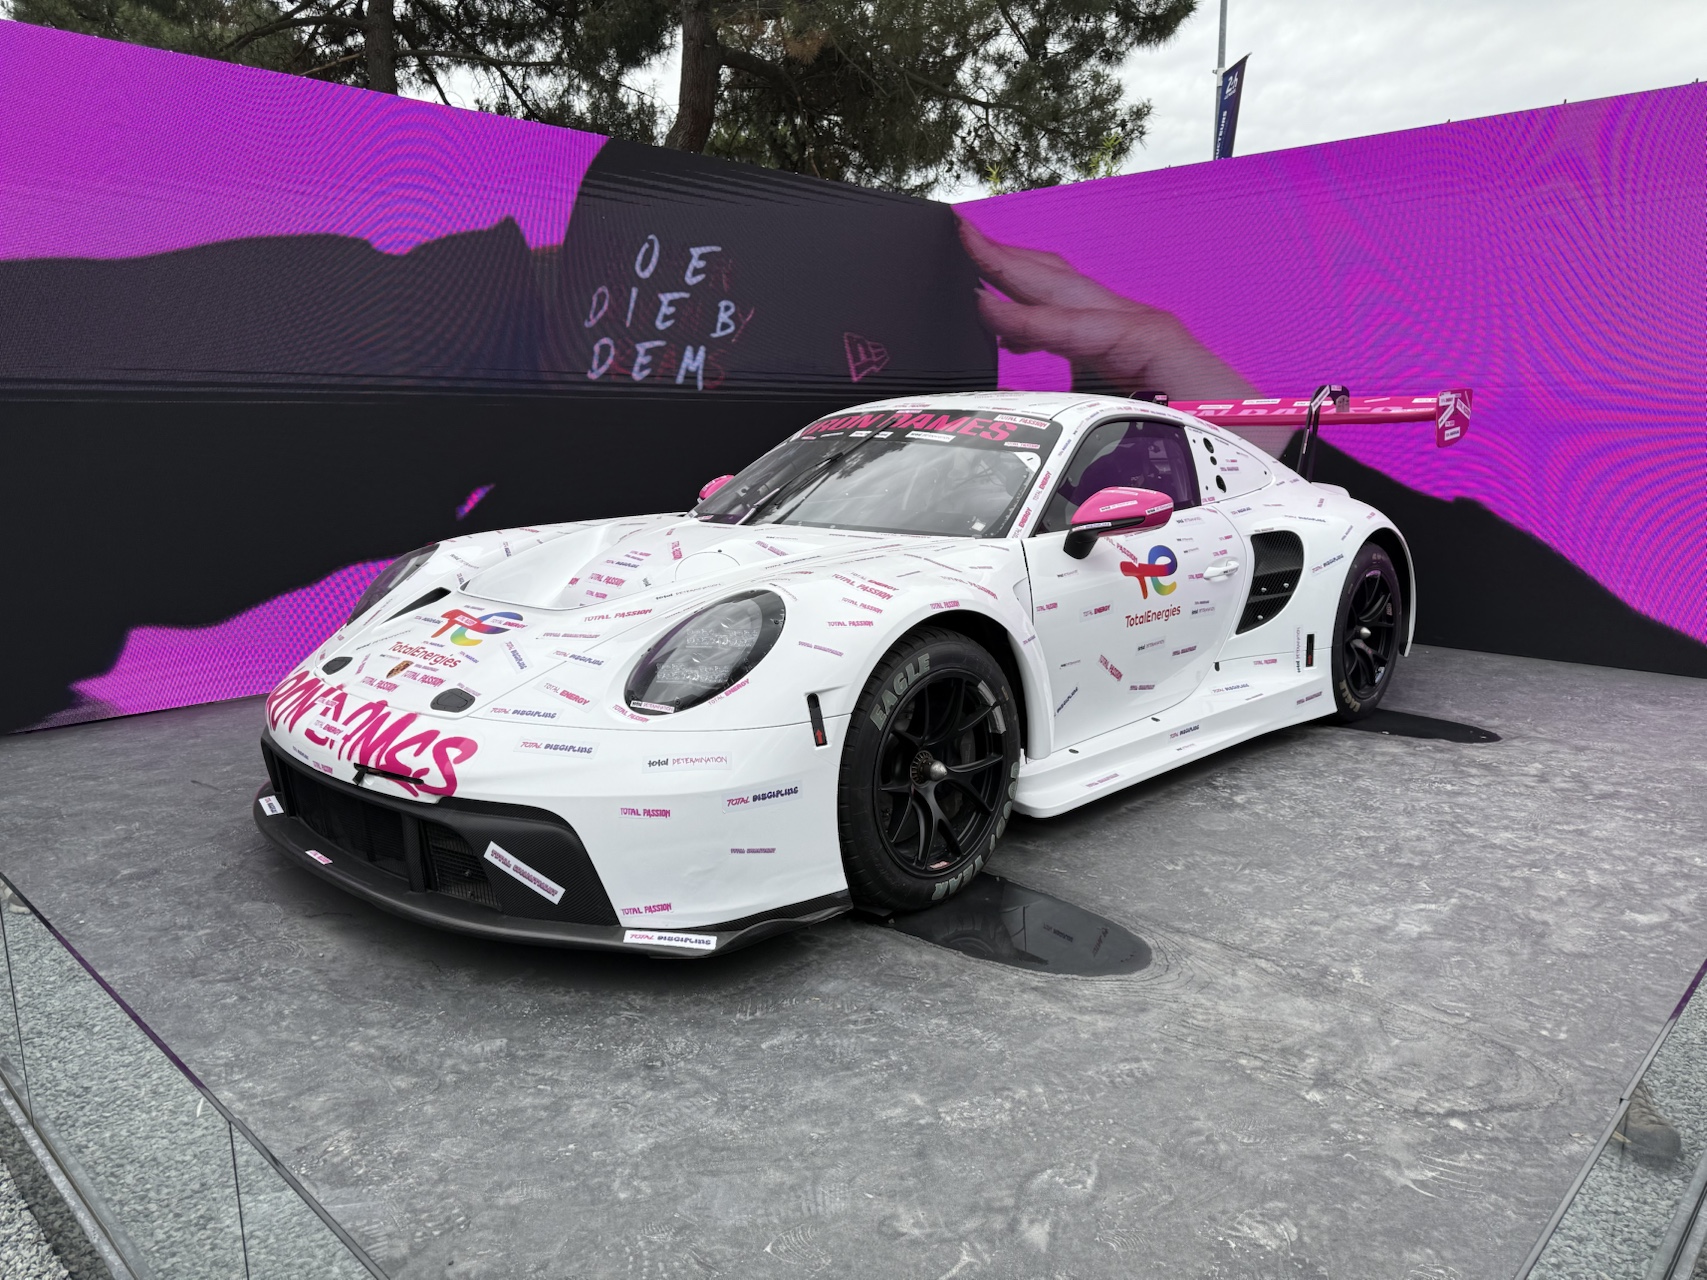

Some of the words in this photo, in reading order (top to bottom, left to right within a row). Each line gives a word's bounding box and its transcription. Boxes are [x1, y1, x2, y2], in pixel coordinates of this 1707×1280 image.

[876, 411, 1018, 441] DAMES
[1039, 471, 1052, 490] ENERGY
[1018, 507, 1033, 528] ENERGY
[832, 573, 855, 587] TOTAL
[857, 583, 894, 600] PASSION
[583, 614, 611, 623] TOTAL
[613, 608, 653, 619] PASSION
[1125, 603, 1181, 628] TotalEnergies
[388, 641, 461, 668] TotalEnergies
[724, 678, 750, 697] ENERGY
[869, 652, 931, 731] EAGLE
[559, 689, 590, 706] ENERGY
[520, 741, 543, 749] TOTAL
[647, 758, 669, 768] total
[672, 756, 728, 766] DETERMINATION
[727, 796, 750, 807] TOTAL
[620, 807, 641, 817] TOTAL
[643, 808, 671, 819] PASSION
[621, 906, 643, 916] TOTAL
[644, 902, 672, 915] PASSION
